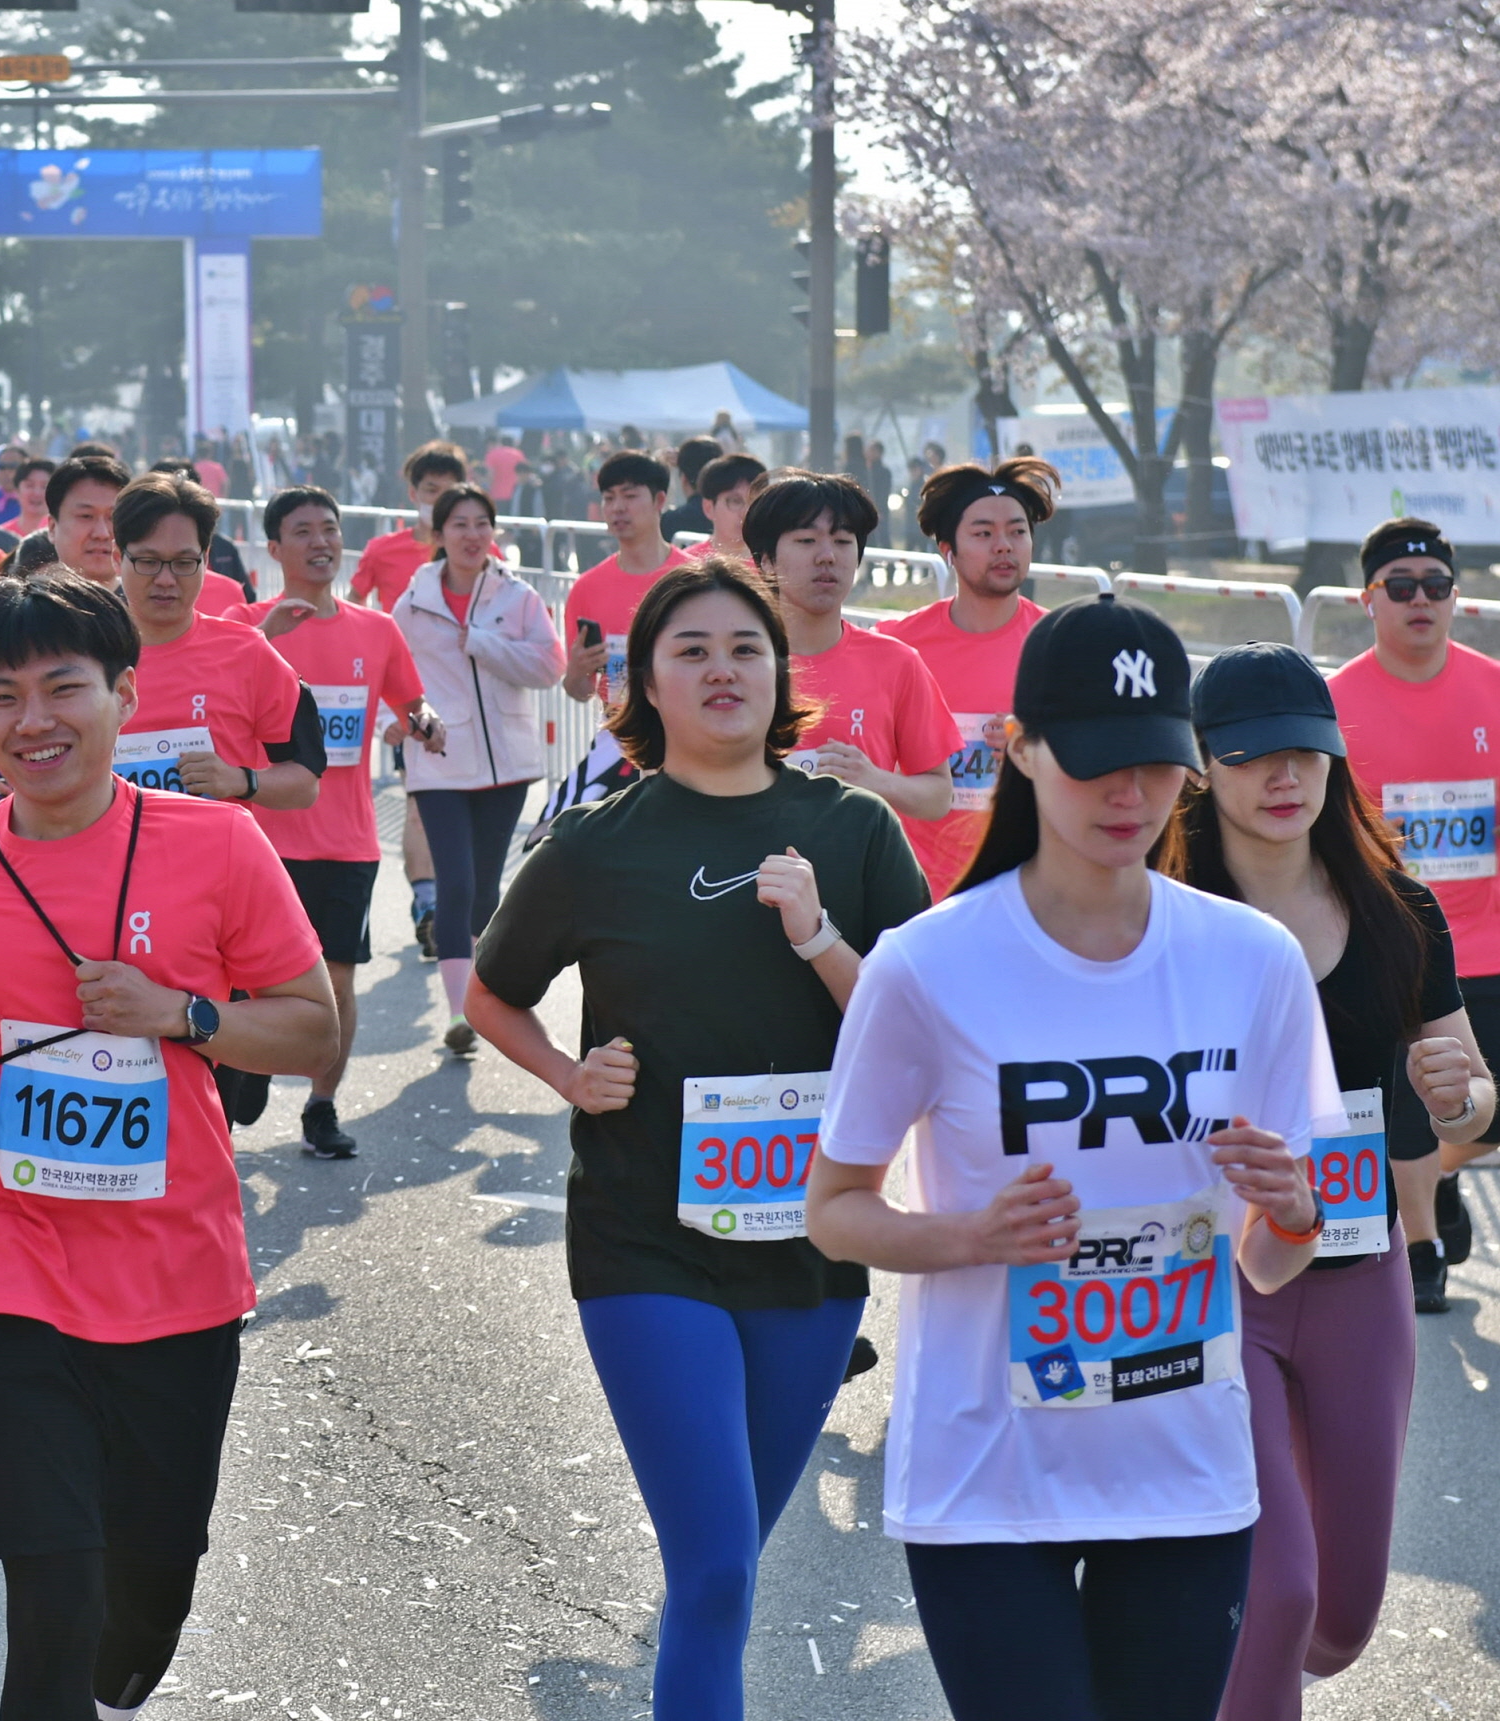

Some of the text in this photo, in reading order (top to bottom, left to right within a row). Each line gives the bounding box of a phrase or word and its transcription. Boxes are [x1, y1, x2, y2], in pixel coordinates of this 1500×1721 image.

[1112, 649, 1157, 698] NY
[64, 1049, 83, 1062] City
[723, 1094, 771, 1107] Golden City
[802, 1093, 825, 1102] 경주시
[998, 1048, 1237, 1156] PRC
[15, 1084, 150, 1149] 11676
[41, 1168, 138, 1187] 한국원자력환경공단
[694, 1133, 819, 1190] 3007
[743, 1209, 806, 1225] 한국원자력환
[1069, 1234, 1155, 1269] PRC
[1028, 1256, 1217, 1344] 30077
[1117, 1357, 1199, 1387] 포항러닝크루
